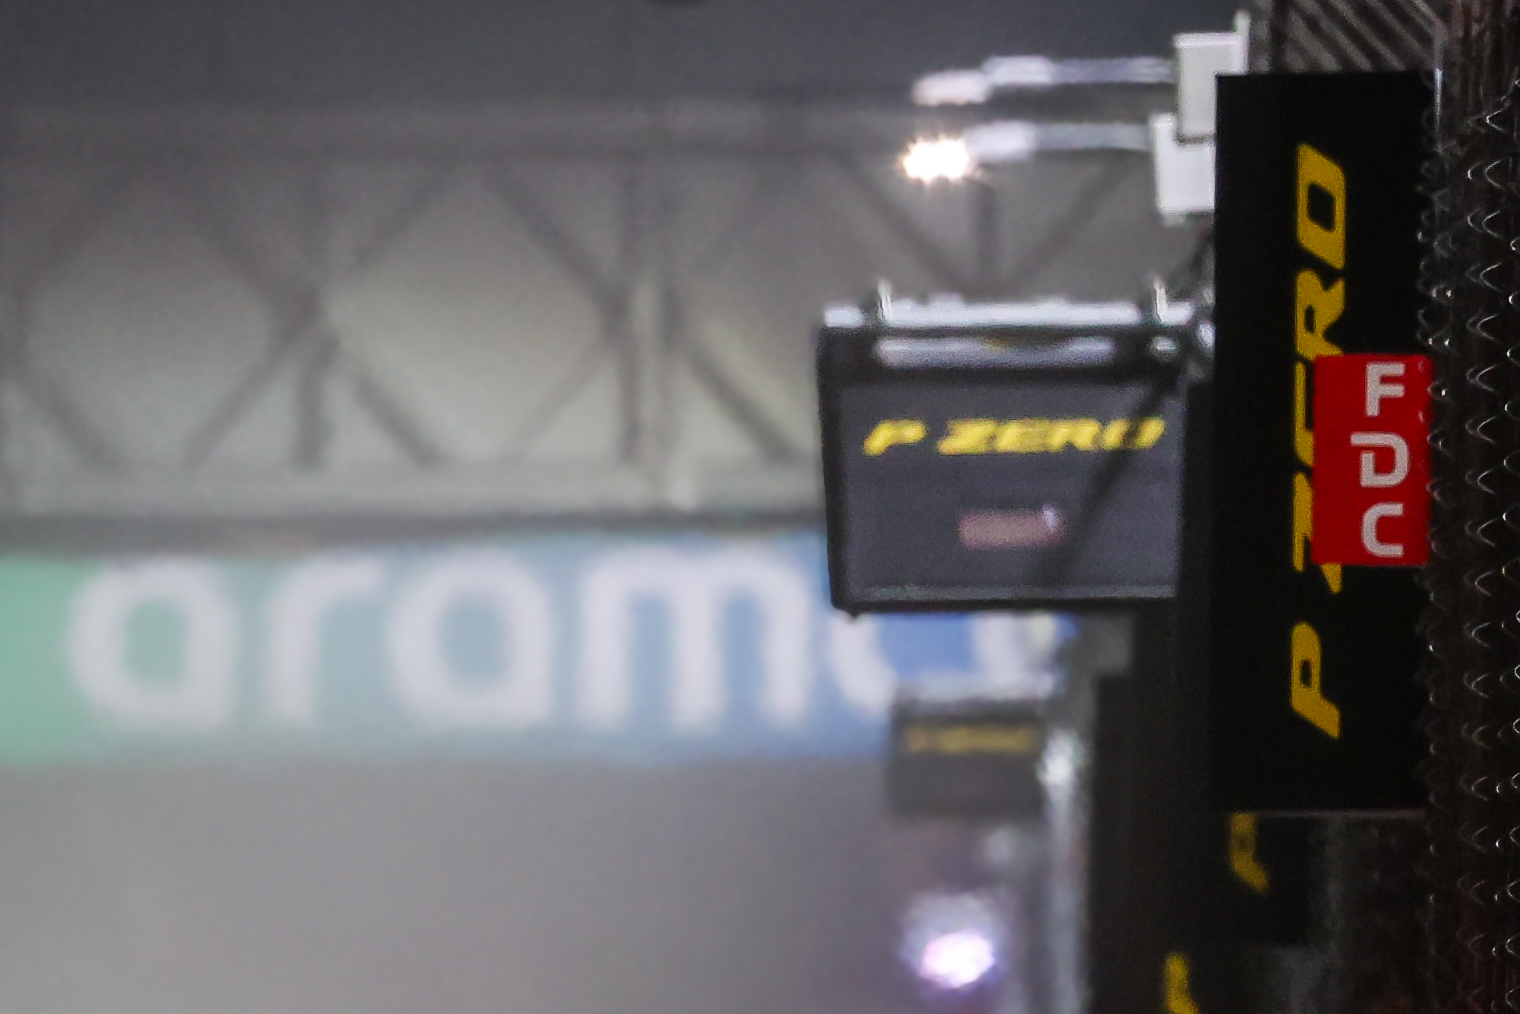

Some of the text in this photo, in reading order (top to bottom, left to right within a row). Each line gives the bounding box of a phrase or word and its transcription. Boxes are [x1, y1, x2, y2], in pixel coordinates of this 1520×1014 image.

[863, 416, 1167, 455] P ZERO
[1349, 362, 1411, 559] FDC
[1291, 622, 1343, 740] P
